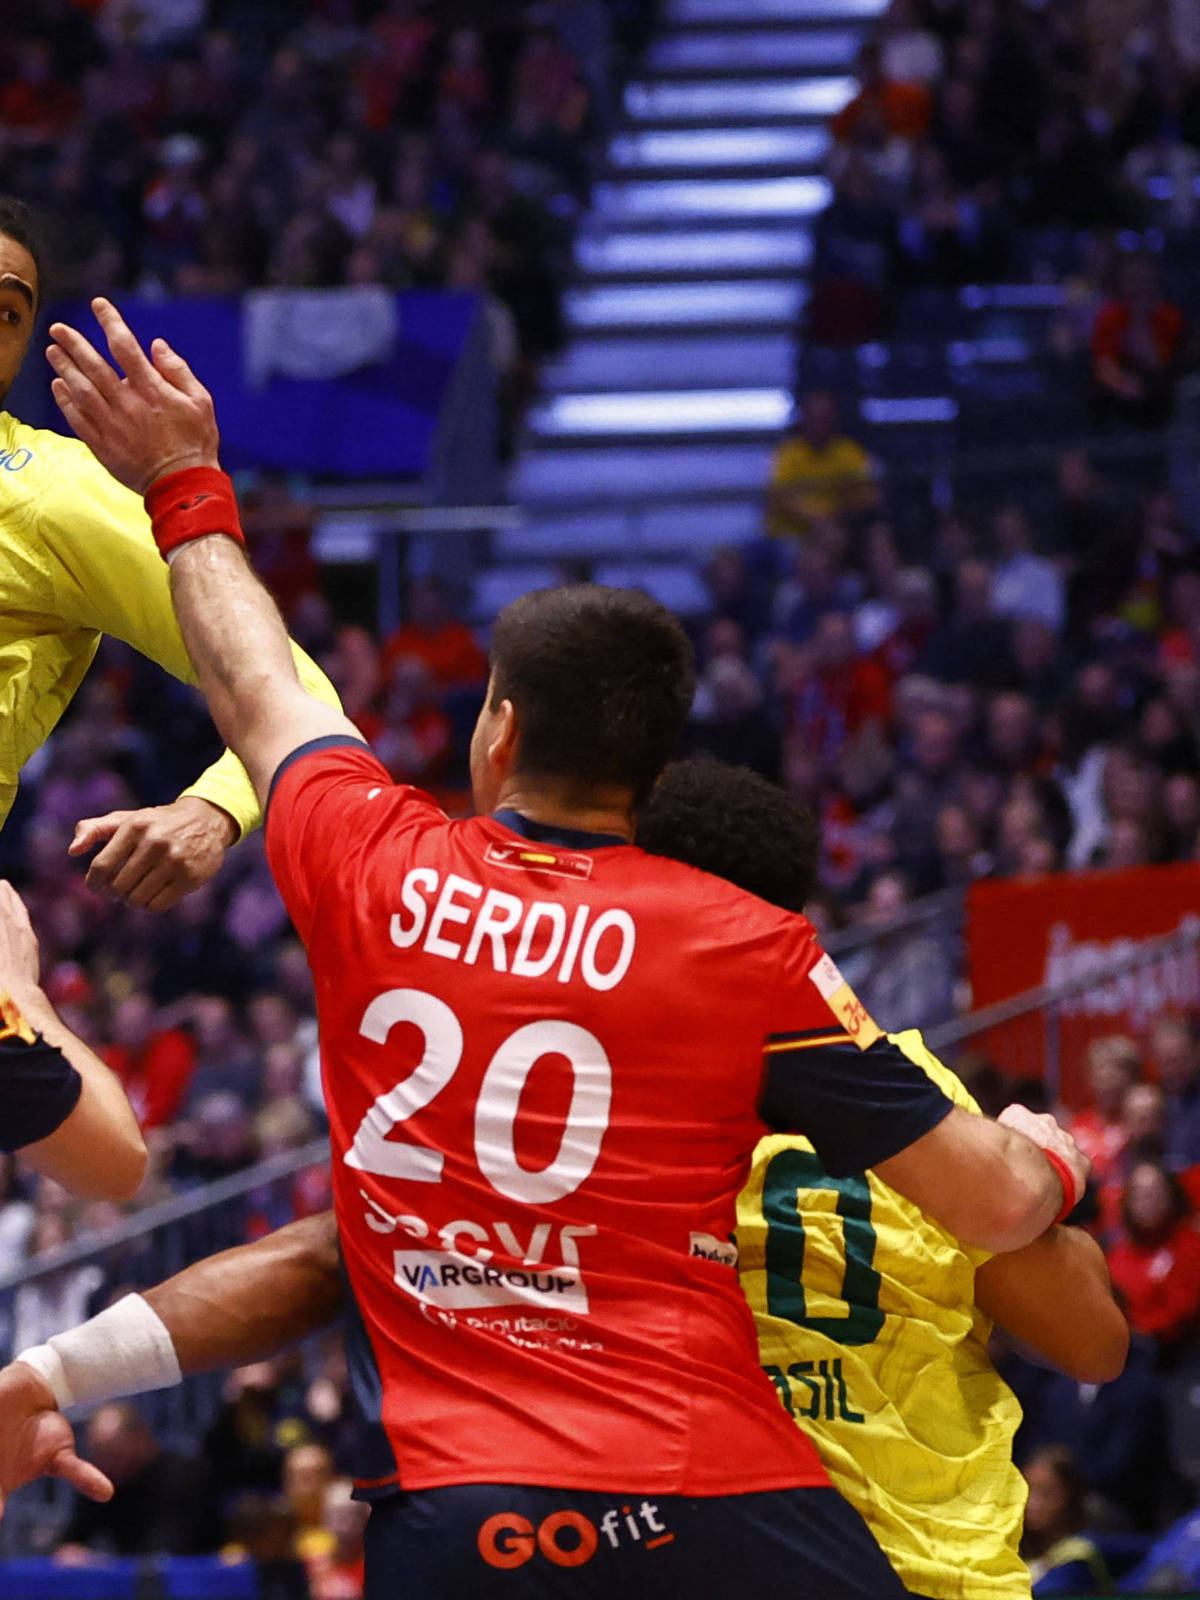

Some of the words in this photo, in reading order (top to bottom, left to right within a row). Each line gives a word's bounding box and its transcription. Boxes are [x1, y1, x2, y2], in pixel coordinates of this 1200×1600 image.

[389, 867, 636, 991] SERDIO
[343, 988, 613, 1204] 20
[402, 1264, 576, 1294] VARGROUP
[760, 1358, 865, 1424] ASIL
